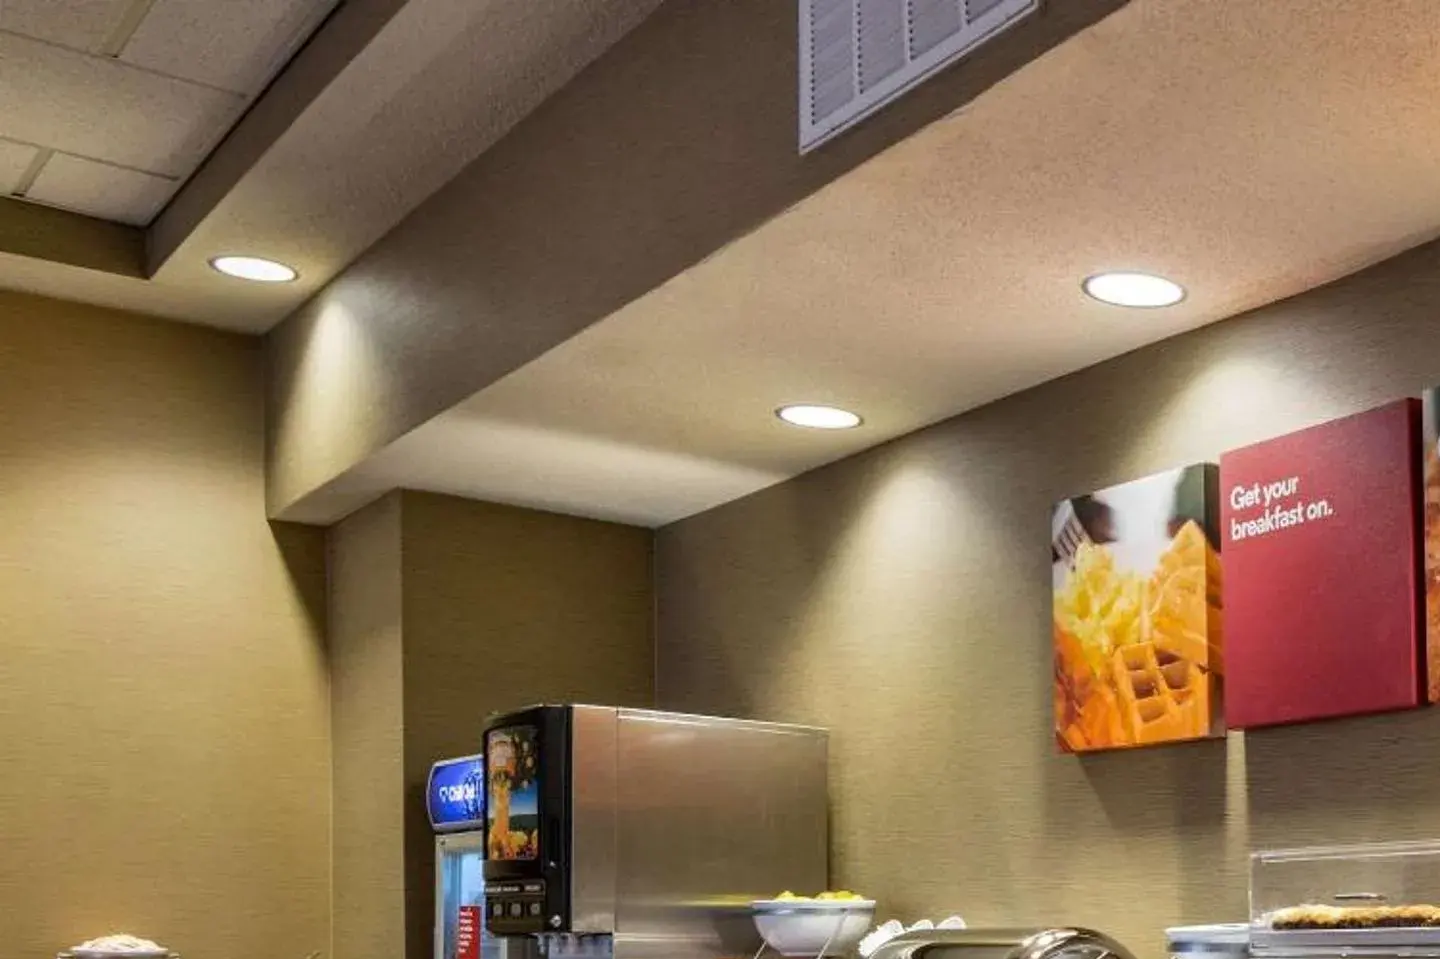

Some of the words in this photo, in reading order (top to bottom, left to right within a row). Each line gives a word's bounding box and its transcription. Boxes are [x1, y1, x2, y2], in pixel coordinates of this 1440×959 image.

[1231, 484, 1262, 510] Get
[1263, 477, 1300, 507] your
[1231, 502, 1305, 541] breakfast
[1306, 498, 1333, 520] on.
